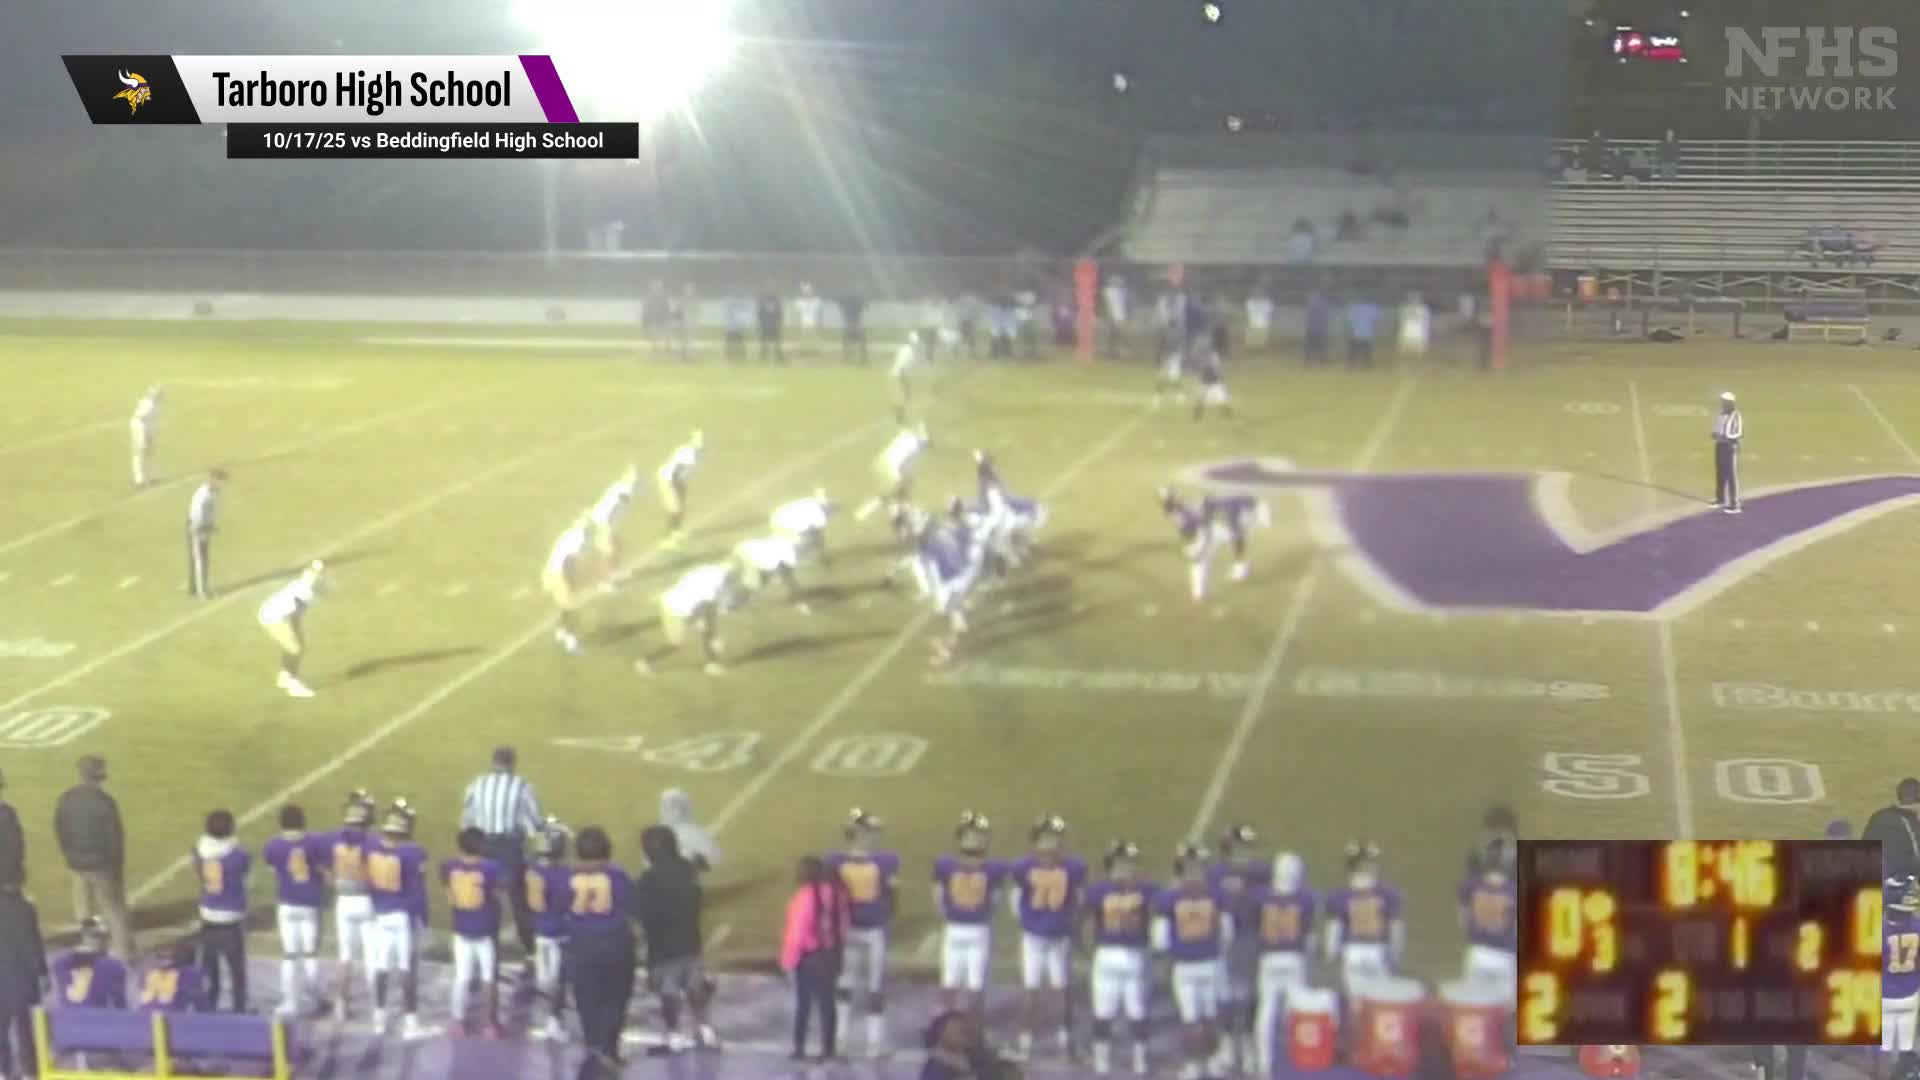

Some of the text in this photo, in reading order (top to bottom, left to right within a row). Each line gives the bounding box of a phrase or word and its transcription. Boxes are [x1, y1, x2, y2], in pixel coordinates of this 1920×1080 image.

[1665, 841, 1776, 907] 8:46
[1548, 887, 1583, 959] 0
[1887, 932, 1919, 974] 17
[1523, 971, 1560, 1042] 2
[1653, 970, 1691, 1040] 2
